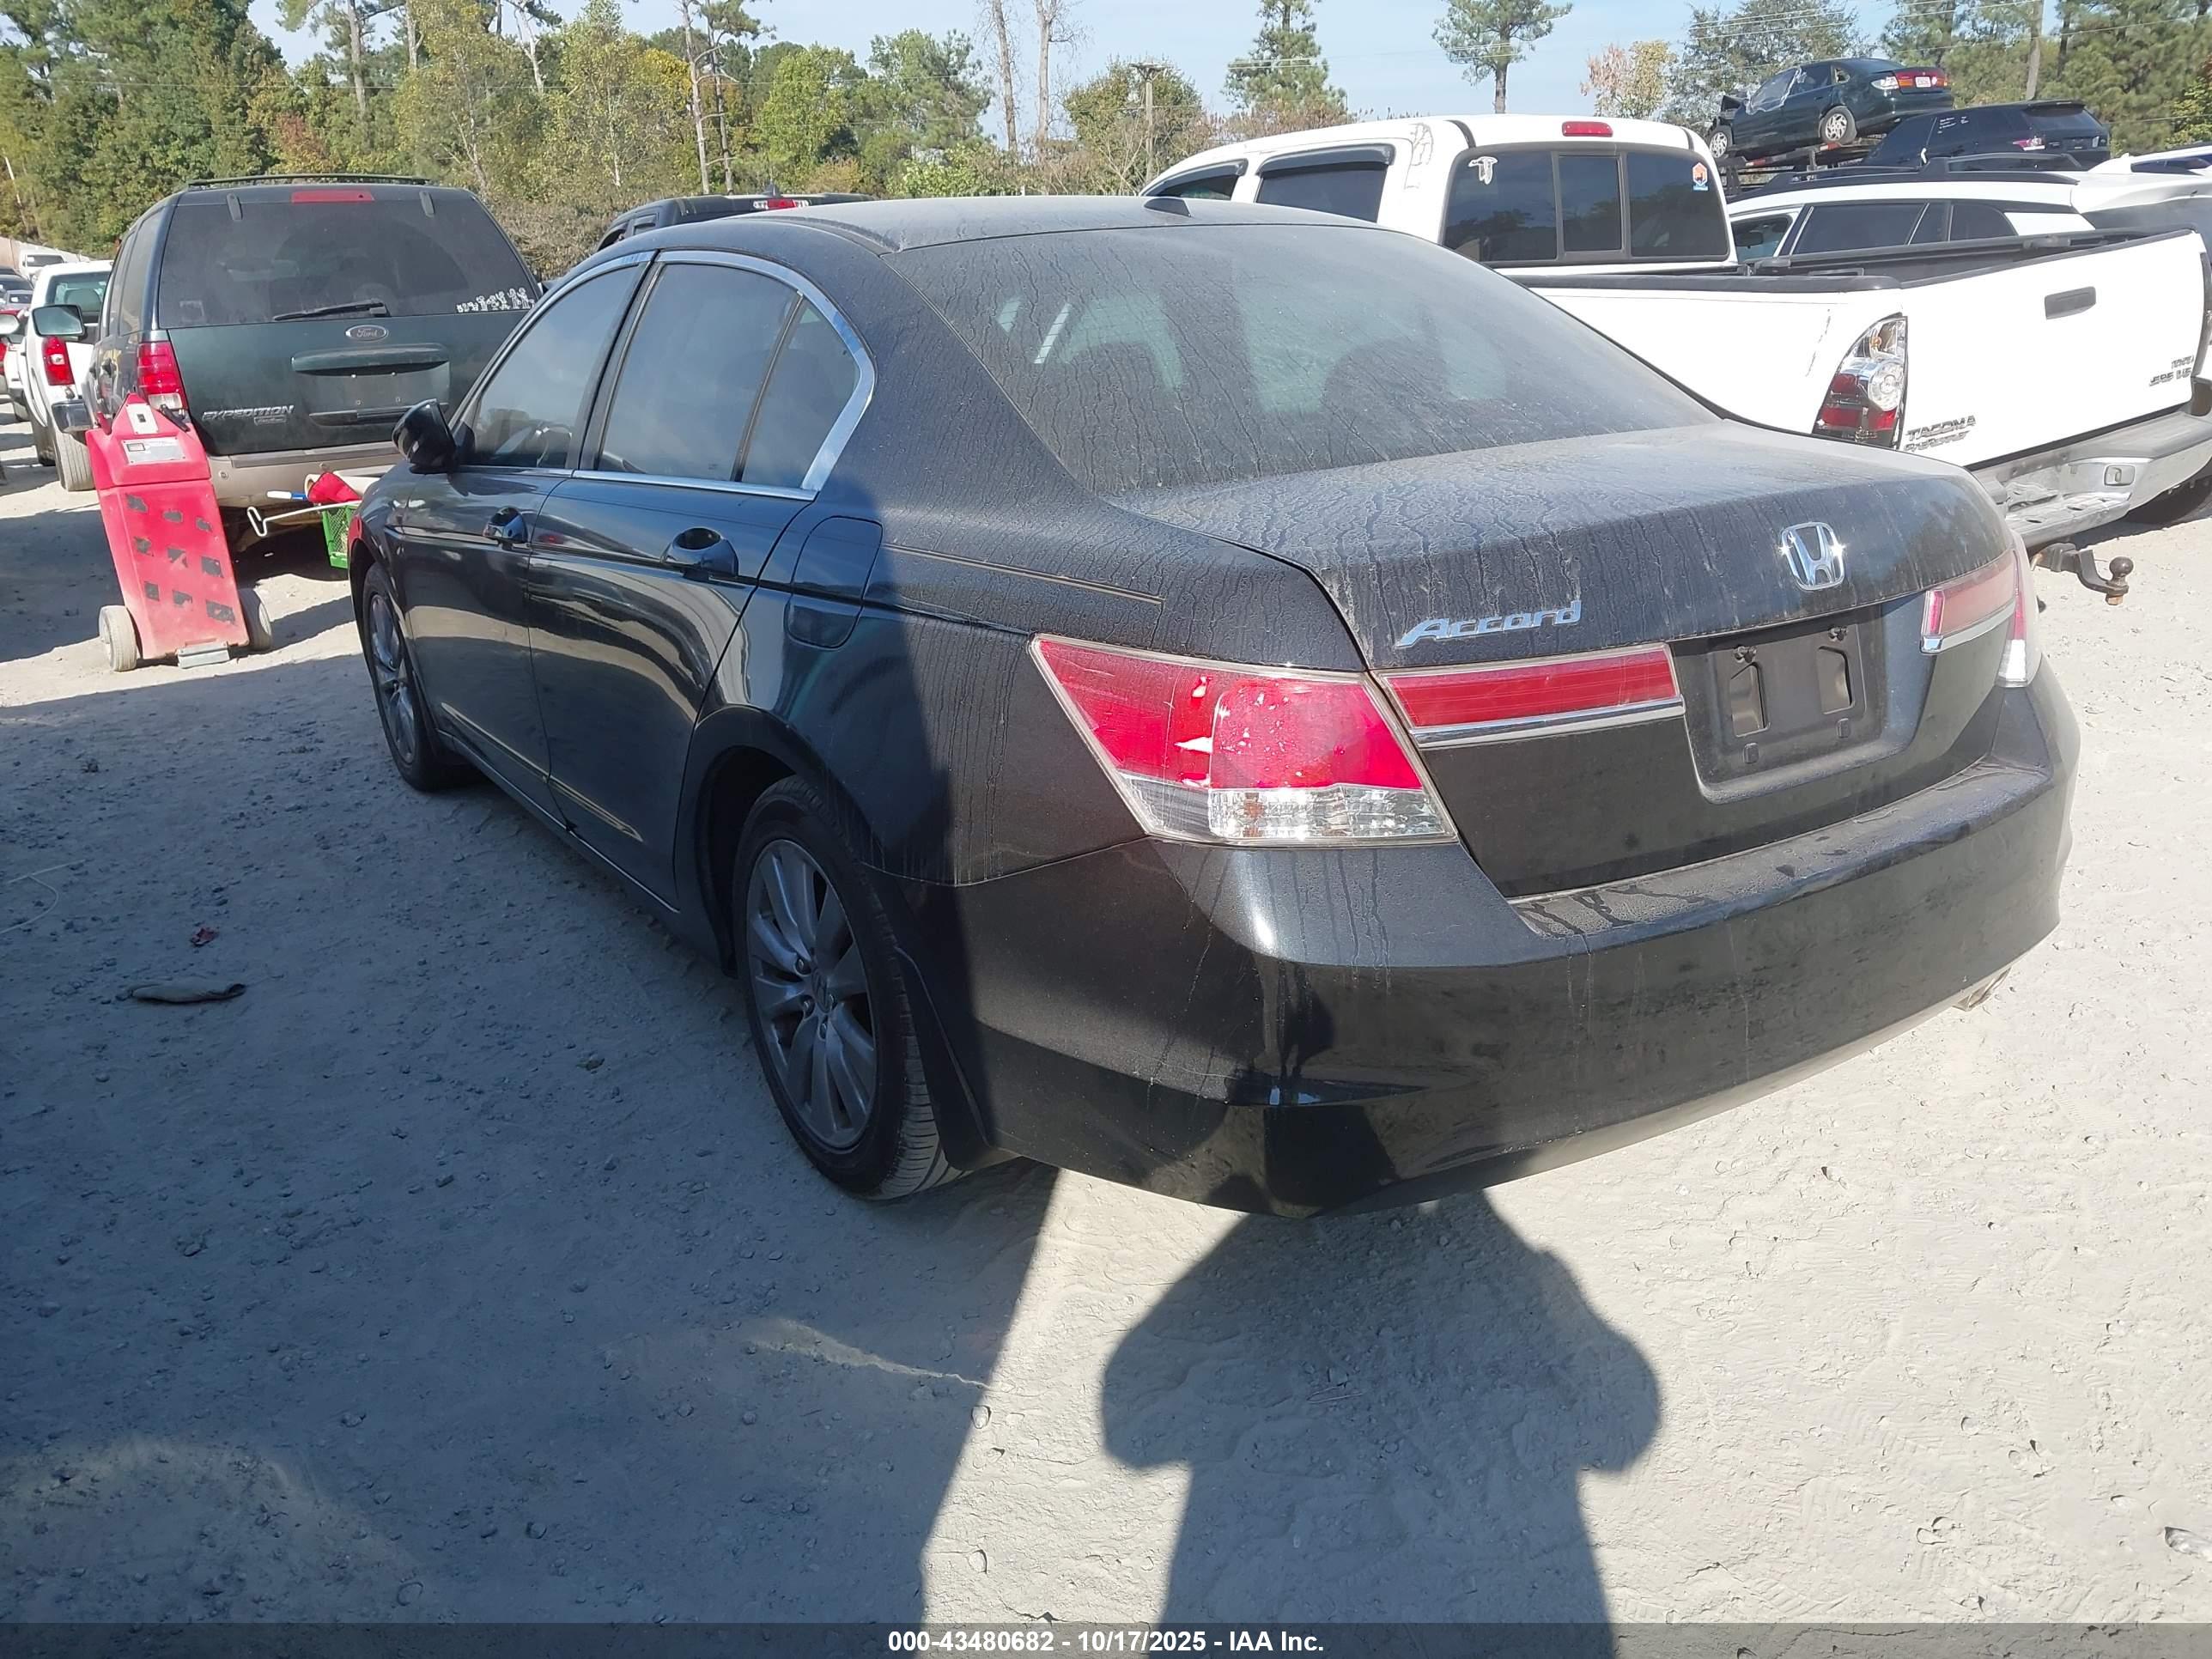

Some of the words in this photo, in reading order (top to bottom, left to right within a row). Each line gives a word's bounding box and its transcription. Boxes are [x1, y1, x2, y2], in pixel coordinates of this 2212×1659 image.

[202, 404, 295, 421] EXPEDITION
[1905, 414, 1977, 441] TACOMA
[1395, 599, 1582, 648] Accord
